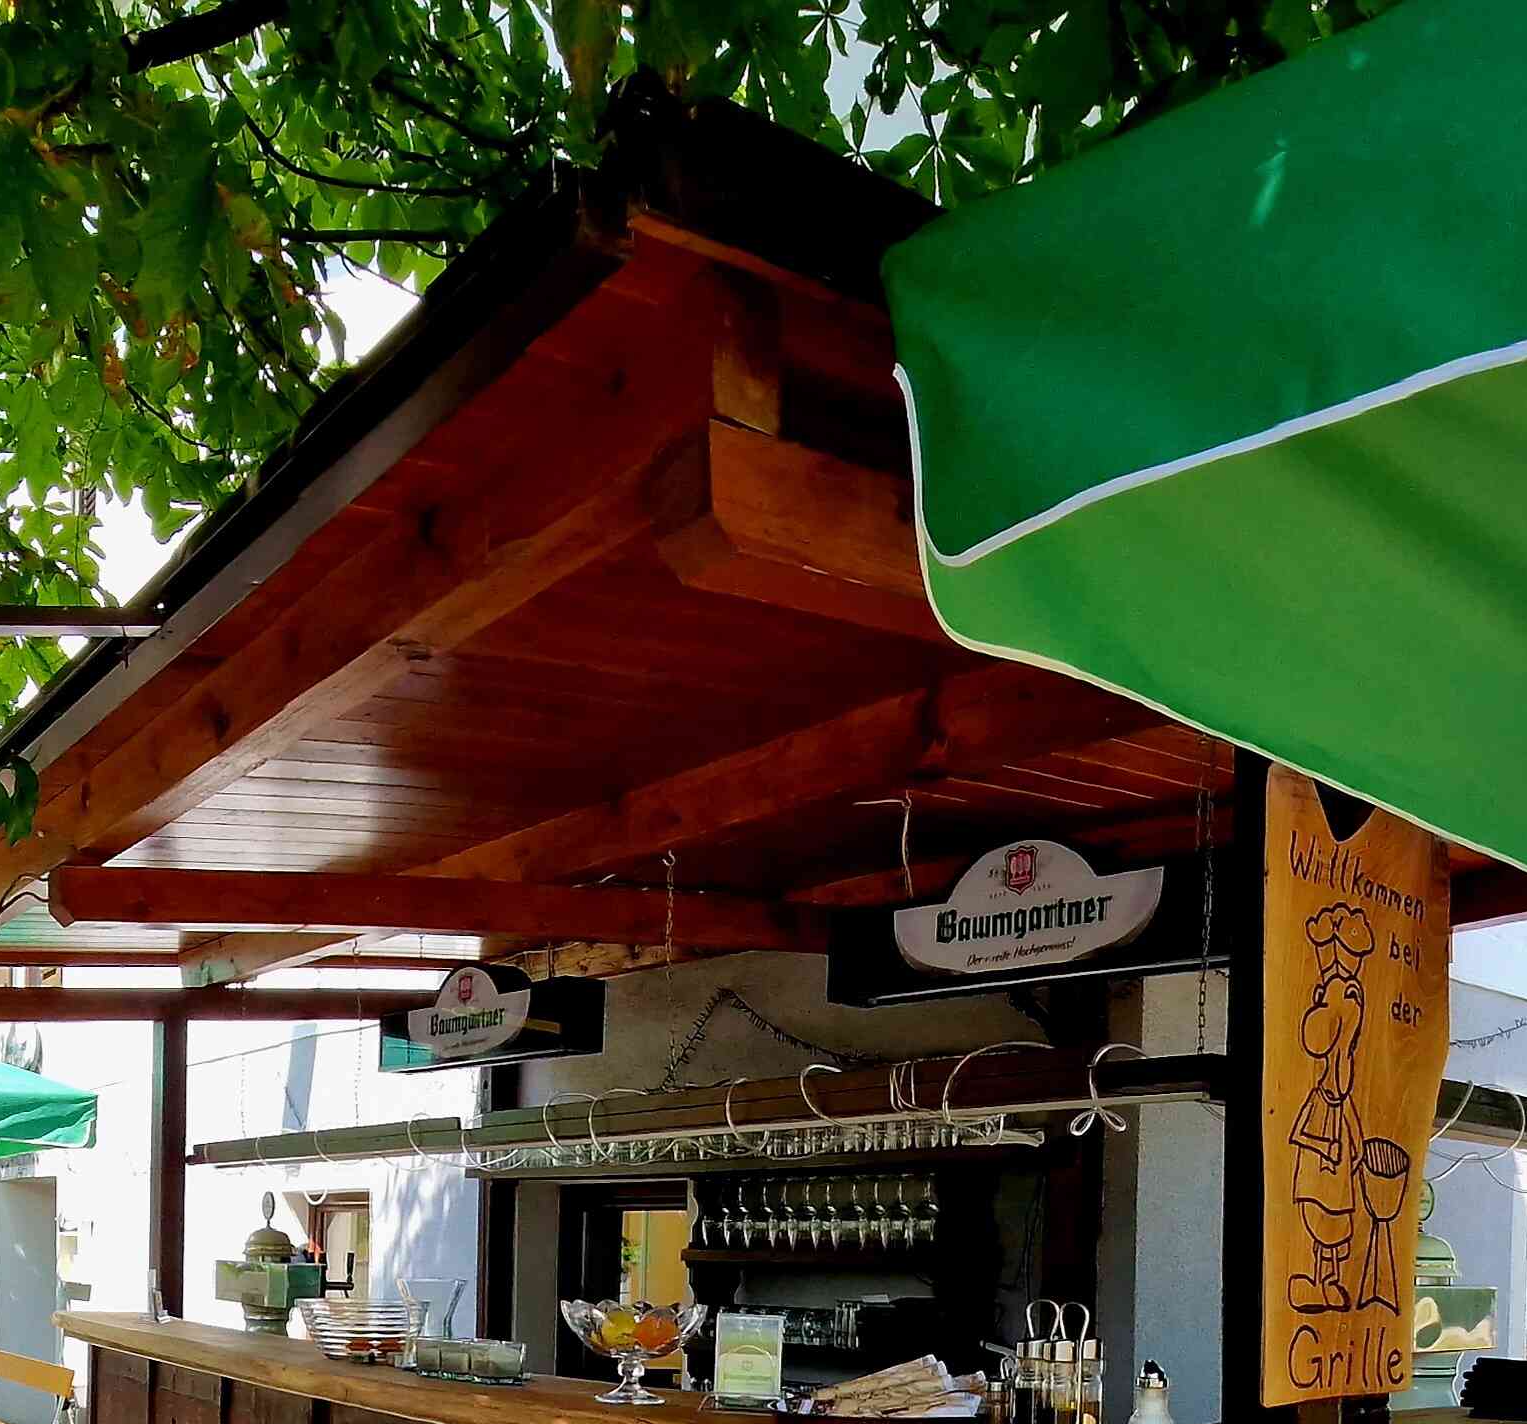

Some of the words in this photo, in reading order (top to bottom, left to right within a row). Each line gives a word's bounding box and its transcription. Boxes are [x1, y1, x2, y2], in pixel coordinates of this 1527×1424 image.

[936, 895, 1113, 944] Baumgartner
[1389, 932, 1421, 972] bei
[430, 1008, 505, 1036] Baumgartner
[1391, 992, 1423, 1028] der
[1288, 1324, 1404, 1389] Grille
